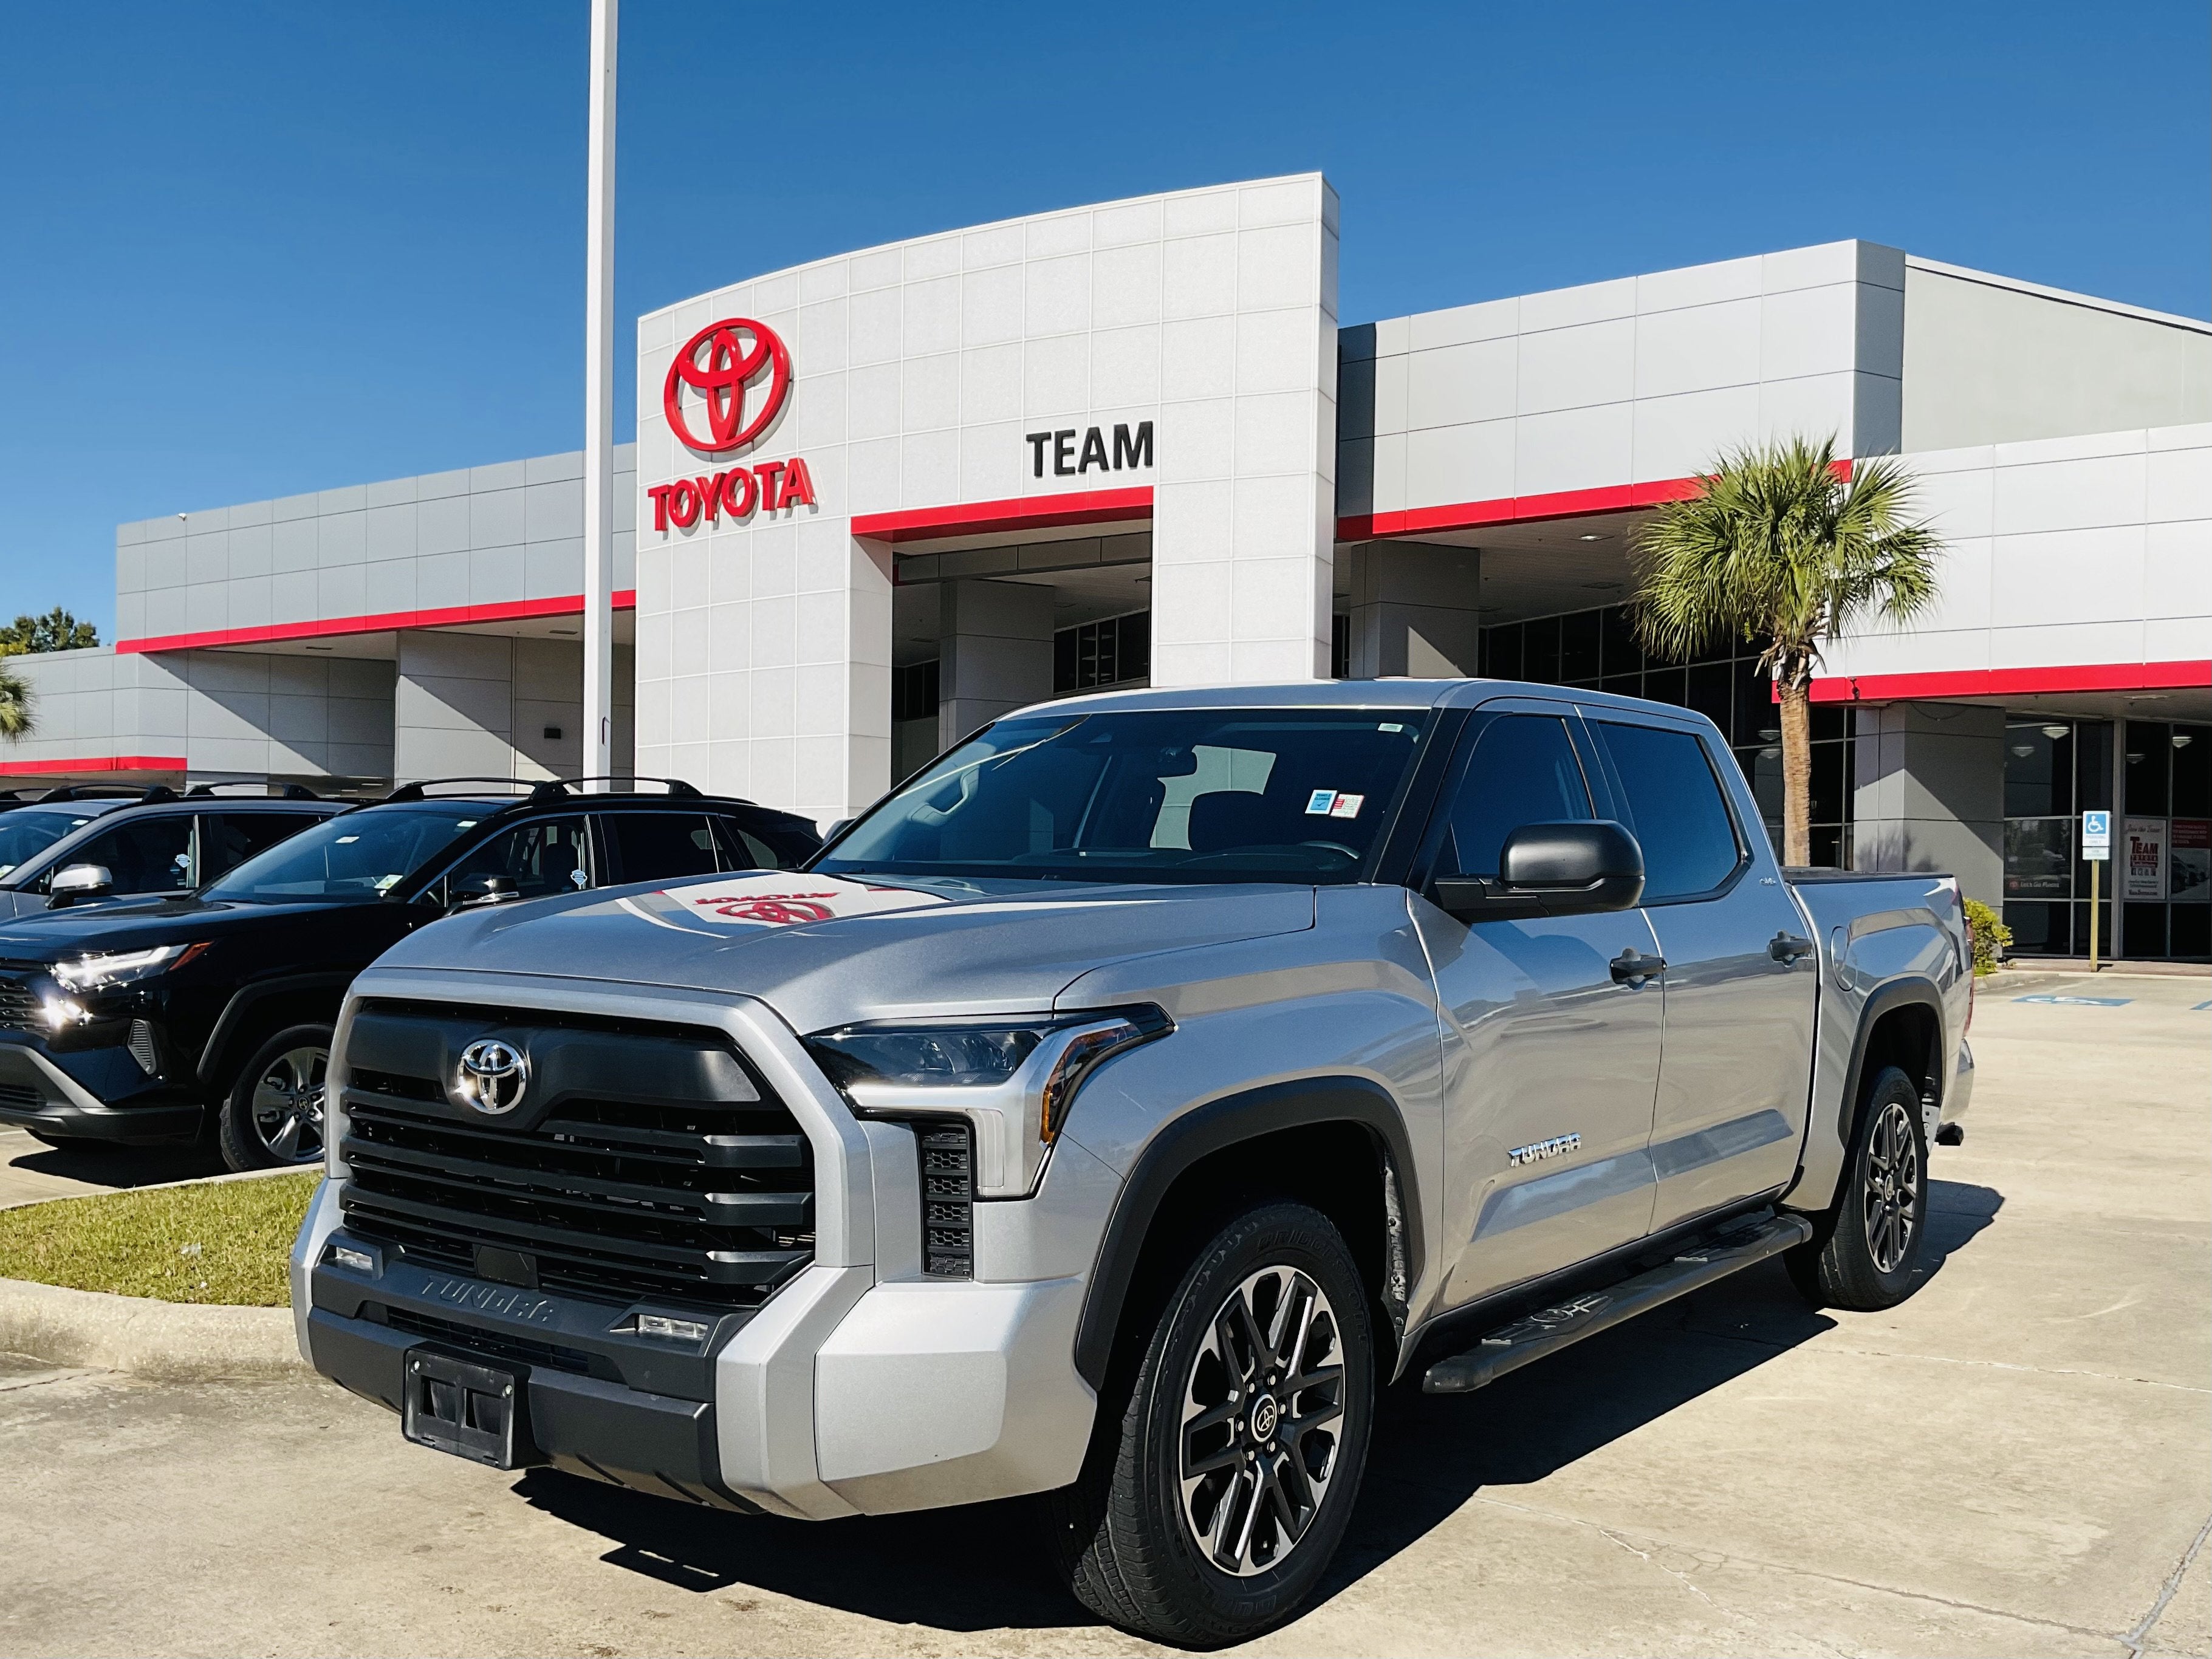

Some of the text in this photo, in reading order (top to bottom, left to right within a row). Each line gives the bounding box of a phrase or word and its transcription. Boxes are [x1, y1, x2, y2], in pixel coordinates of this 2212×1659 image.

[1026, 420, 1153, 477] TEAM
[648, 457, 817, 532] TOYOTA
[1507, 1132, 1581, 1167] TUNDRA
